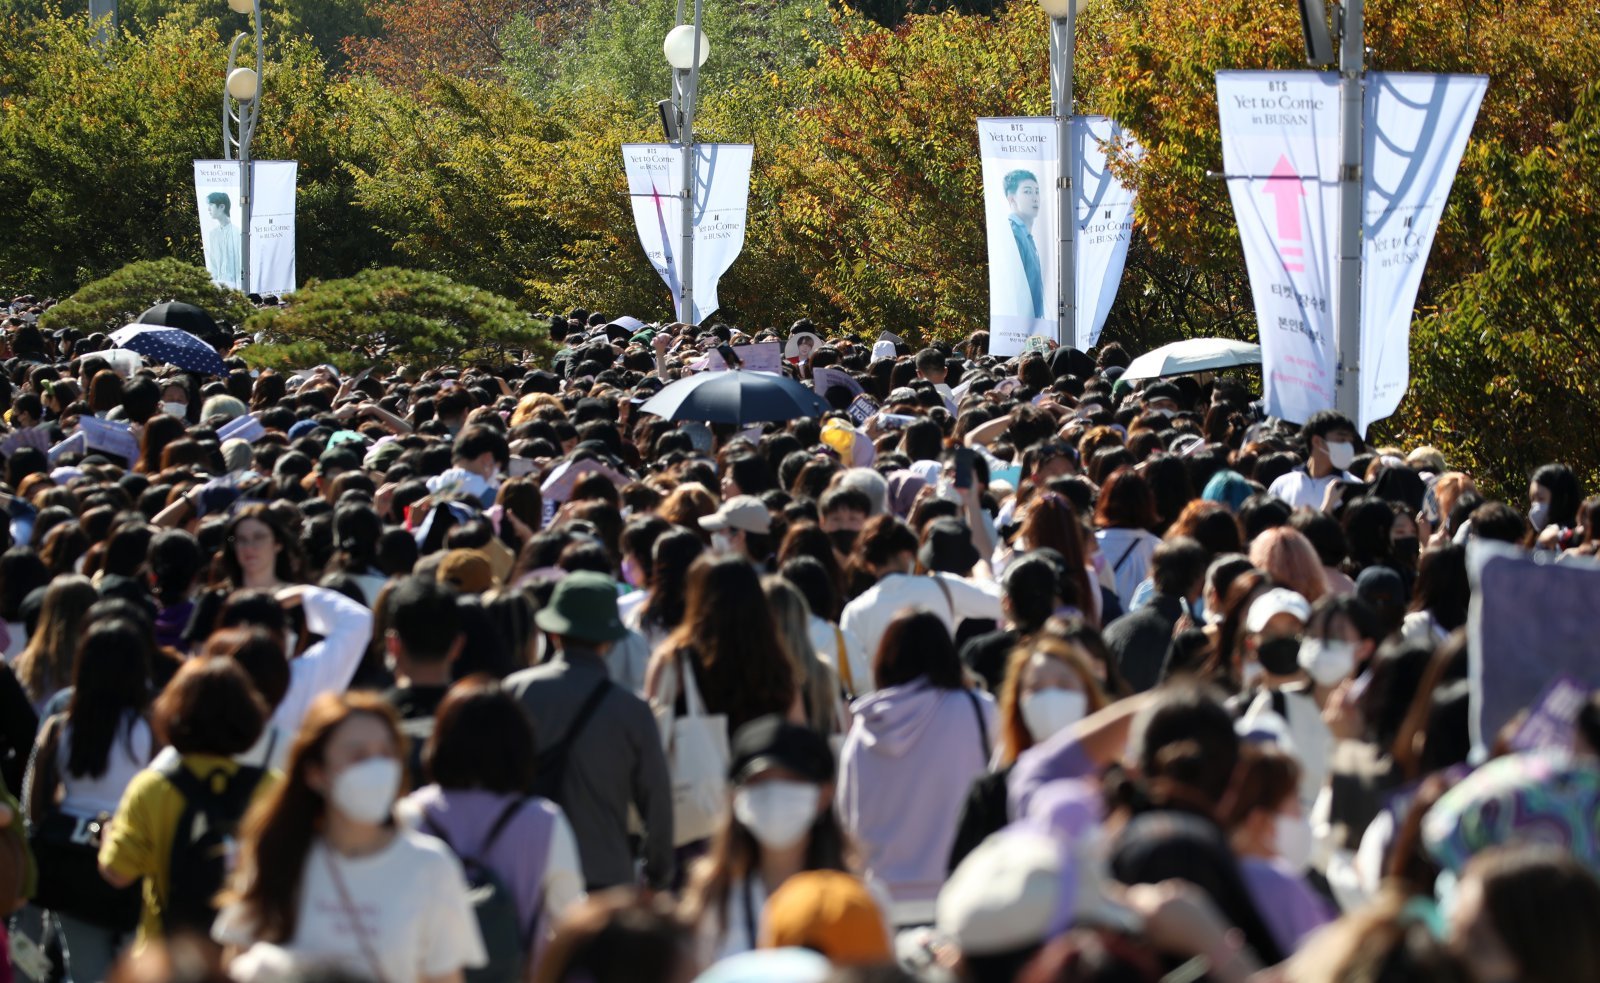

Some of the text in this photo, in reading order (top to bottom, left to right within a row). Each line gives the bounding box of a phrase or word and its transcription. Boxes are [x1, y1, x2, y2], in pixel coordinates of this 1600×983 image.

[1269, 81, 1288, 92] BTS
[1233, 94, 1324, 110] Yet to Come
[1252, 113, 1308, 125] in BUSAN
[988, 131, 1047, 143] Yet to Come
[1009, 145, 1037, 153] BUSAN
[630, 155, 642, 163] Yet
[652, 154, 674, 163] Come
[646, 163, 667, 171] BUSAN
[715, 221, 740, 231] Come
[1081, 220, 1131, 235] Yet to Com
[708, 231, 731, 240] BUSAN
[1096, 232, 1126, 244] BUSAN
